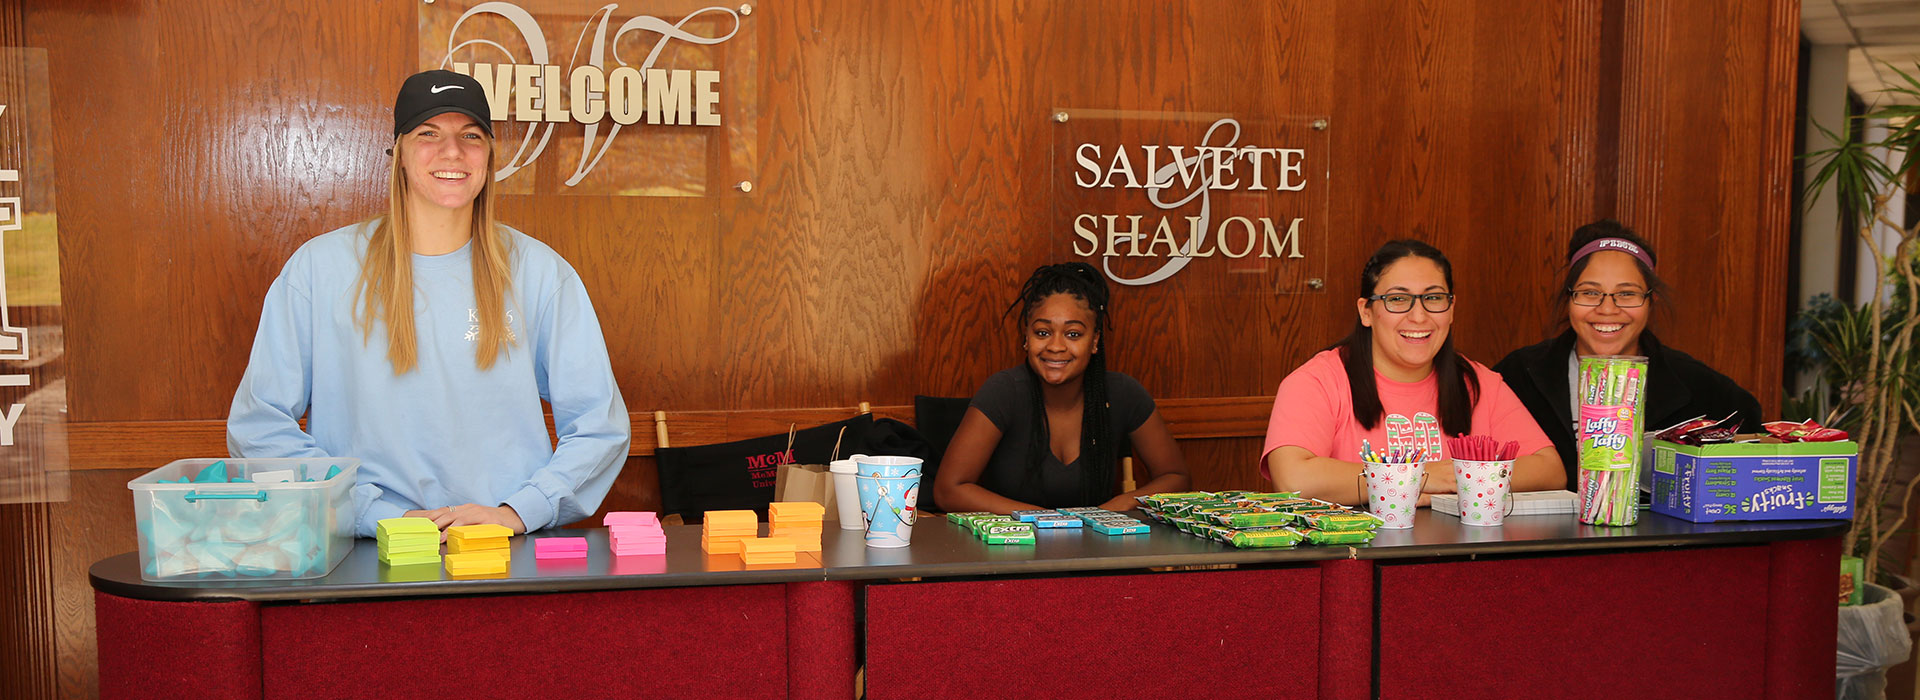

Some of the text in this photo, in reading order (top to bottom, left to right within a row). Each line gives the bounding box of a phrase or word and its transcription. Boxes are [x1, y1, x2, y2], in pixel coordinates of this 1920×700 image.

[453, 62, 721, 126] WELCOME
[1075, 143, 1307, 191] SALVETE
[1073, 213, 1305, 259] SHALOM
[0, 403, 26, 446] Y
[1585, 417, 1618, 434] Laffy
[1591, 433, 1627, 451] Taffy
[745, 449, 797, 469] McM
[1763, 484, 1793, 495] Snacks
[1723, 503, 1737, 515] 36
[989, 526, 1031, 534] extra
